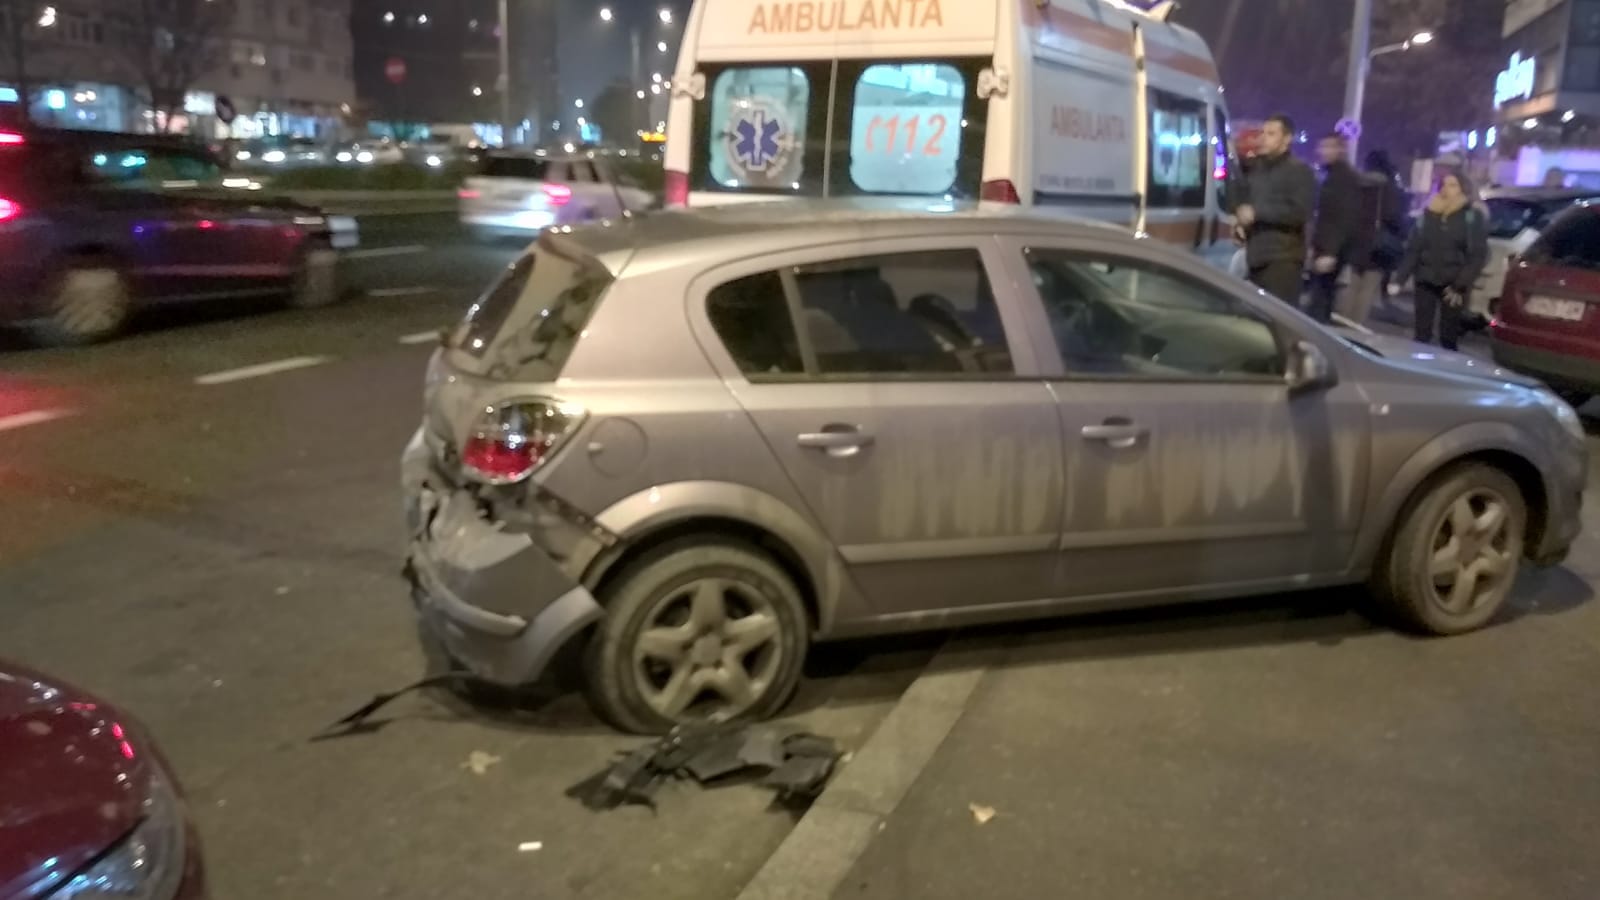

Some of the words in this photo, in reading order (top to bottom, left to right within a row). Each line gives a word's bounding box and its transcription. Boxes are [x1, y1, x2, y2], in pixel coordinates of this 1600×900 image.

[747, 0, 943, 34] AMBULANTA
[884, 114, 947, 155] 112
[1050, 104, 1127, 143] AMBULANTA
